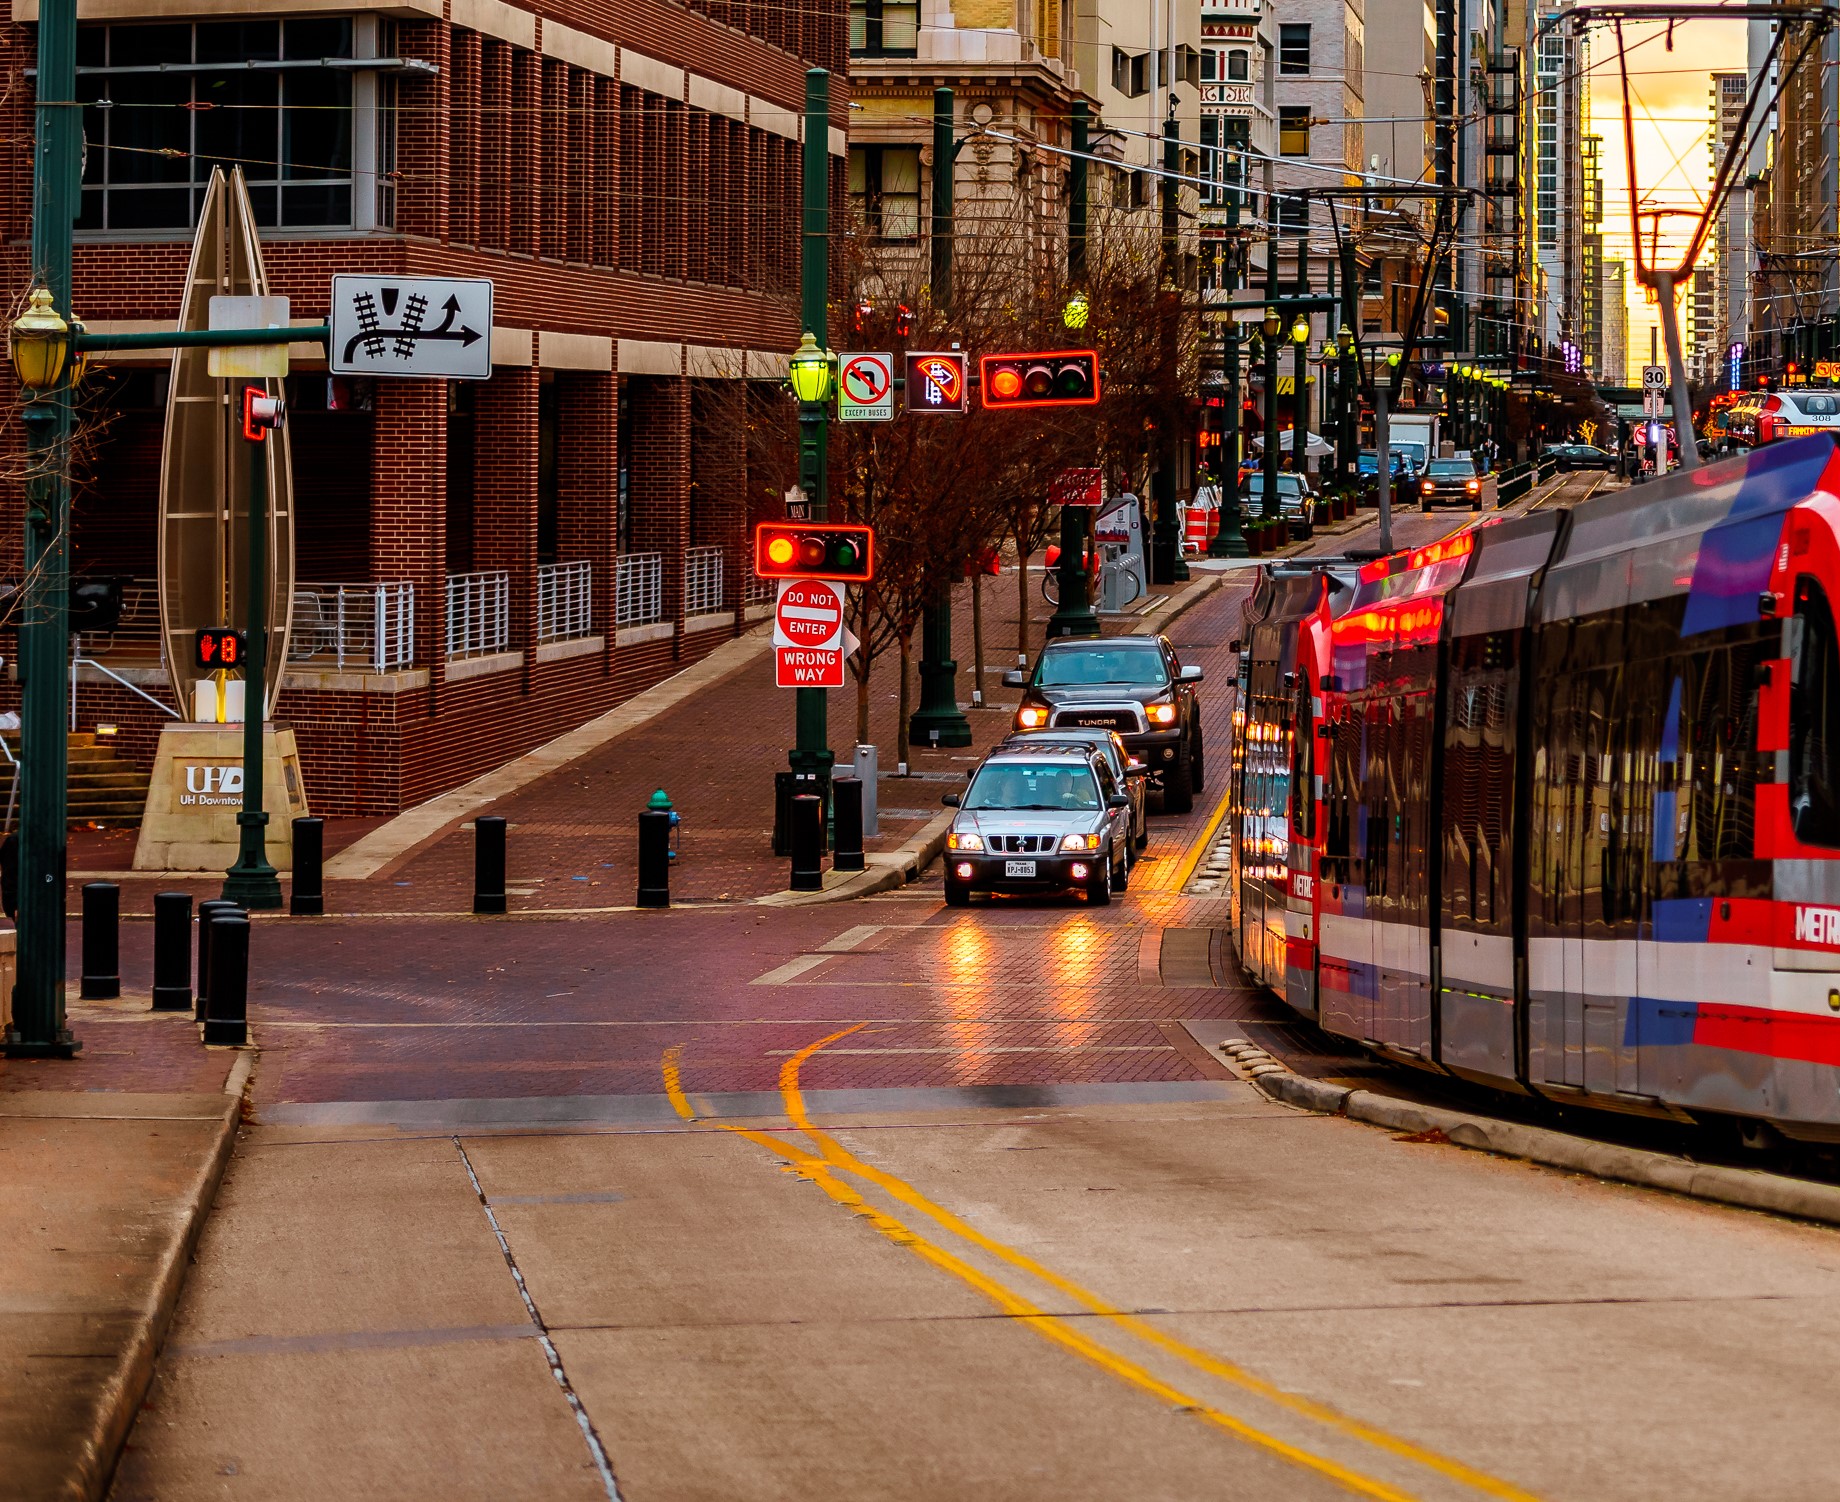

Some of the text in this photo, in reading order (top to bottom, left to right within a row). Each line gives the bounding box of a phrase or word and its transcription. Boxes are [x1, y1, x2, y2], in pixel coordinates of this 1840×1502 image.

[1645, 371, 1663, 383] 30
[790, 505, 805, 518] MAIN
[788, 591, 834, 606] DO NOT
[790, 621, 826, 636] ENTER
[784, 652, 836, 666] WRONG
[795, 668, 825, 681] WAY
[180, 795, 244, 805] UH Downtow
